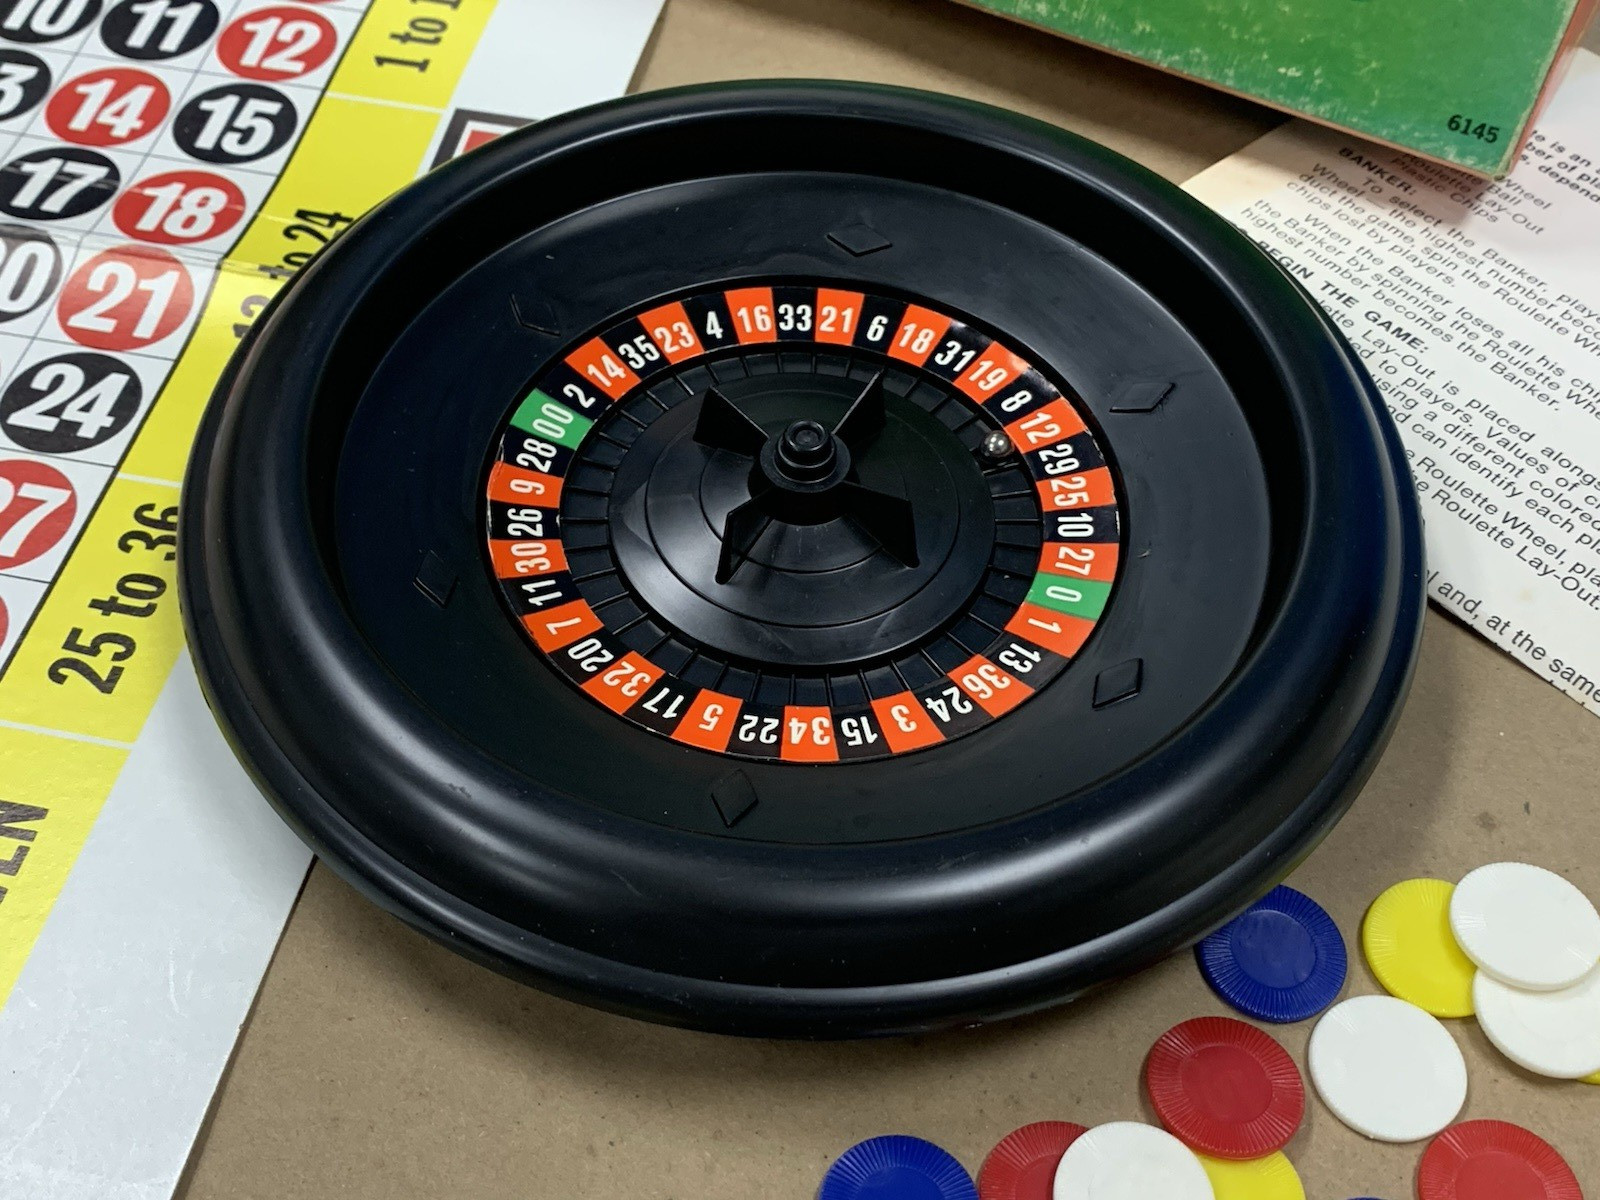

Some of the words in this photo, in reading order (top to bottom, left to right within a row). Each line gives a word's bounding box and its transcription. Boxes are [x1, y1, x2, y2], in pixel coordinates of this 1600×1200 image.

[2, 0, 88, 36] 10
[125, 0, 210, 53] 11
[389, 17, 448, 45] to
[239, 15, 323, 74] 12
[374, 55, 431, 73] 1
[67, 78, 155, 139] 14
[198, 93, 281, 157] 15
[1446, 113, 1499, 145] 6145
[1550, 141, 1566, 153] is
[1569, 153, 1591, 167] an
[1557, 160, 1578, 174] of
[7, 156, 107, 214] 17
[1338, 147, 1417, 196] BANKER:
[135, 181, 229, 239] 18
[1450, 191, 1499, 223] Chips
[1486, 183, 1522, 206] Ball
[1475, 191, 1545, 235] Lay-Out
[1287, 181, 1331, 211] chips
[1332, 208, 1366, 231] lost
[1366, 228, 1390, 244] by
[1388, 244, 1456, 288] players.
[1313, 163, 1366, 198] Wheel
[1389, 208, 1416, 228] the
[1419, 226, 1485, 269] highest
[1487, 268, 1558, 310] number
[1363, 177, 1383, 194] To
[1389, 195, 1443, 227] select
[1447, 228, 1475, 248] the
[1481, 248, 1548, 293] Banker,
[1299, 173, 1338, 197] duct
[1338, 196, 1365, 215] the
[1367, 214, 1416, 248] game,
[1421, 246, 1459, 271] spin
[1461, 269, 1490, 289] the
[1493, 287, 1570, 335] Roulette
[0, 238, 55, 313] 0
[66, 261, 184, 339] 21
[1241, 207, 1304, 249] highest
[1304, 248, 1372, 290] number
[1373, 289, 1454, 343] becomes
[1457, 341, 1487, 363] the
[1490, 361, 1560, 411] Banker.
[1254, 199, 1282, 219] the
[1284, 217, 1346, 257] Banker
[1346, 255, 1370, 273] by
[1371, 272, 1447, 322] spinning
[1450, 319, 1479, 341] the
[1482, 339, 1561, 391] Roulette
[1304, 213, 1352, 246] When
[1355, 246, 1384, 266] the
[1388, 265, 1453, 306] Banker
[1455, 306, 1504, 339] loses
[1508, 339, 1535, 356] all
[1536, 355, 1565, 377] his
[705, 310, 723, 340] 4
[736, 304, 772, 334] 16
[778, 304, 812, 332] 33
[819, 305, 853, 333] 21
[866, 314, 888, 342] 6
[1319, 280, 1360, 309] THE
[1364, 310, 1429, 353] GAME:
[617, 334, 661, 371] 35
[653, 321, 695, 354] 23
[898, 322, 936, 354] 18
[586, 353, 626, 388] 14
[934, 340, 976, 373] 31
[968, 359, 1008, 391] 19
[1361, 329, 1436, 380] Lay-Out
[1442, 380, 1460, 396] is
[1465, 398, 1536, 443] placed
[6, 362, 131, 440] 24
[562, 383, 596, 409] 2
[1000, 389, 1033, 413] 8
[1019, 411, 1061, 444] 12
[1378, 359, 1398, 375] to
[1401, 377, 1473, 427] players.
[1486, 426, 1550, 475] Values
[1555, 477, 1581, 492] of
[515, 437, 558, 474] 28
[1038, 443, 1079, 475] 29
[1423, 410, 1438, 422] a
[1443, 422, 1525, 478] different
[509, 478, 546, 496] 9
[1050, 475, 1090, 507] 25
[1412, 423, 1447, 449] can
[1449, 446, 1524, 498] identify
[1525, 498, 1575, 533] each
[0, 476, 72, 558] 7
[507, 507, 543, 538] 26
[1057, 512, 1094, 538] 10
[1416, 456, 1499, 515] Roulette
[1501, 511, 1567, 565] Wheel,
[510, 541, 551, 574] 30
[1054, 545, 1095, 576] 27
[1431, 488, 1514, 548] Roulette
[1516, 545, 1600, 611] Lay-Out.
[88, 572, 167, 618] to
[521, 579, 563, 607] 11
[1045, 585, 1083, 603] 0
[545, 616, 582, 636] 7
[1027, 616, 1063, 635] 1
[1438, 582, 1482, 620] and,
[1486, 615, 1512, 635] at
[1511, 629, 1547, 661] the
[47, 627, 137, 694] 25
[567, 637, 615, 673] 20
[998, 642, 1042, 674] 13
[602, 660, 652, 697] 32
[961, 663, 1012, 700] 36
[642, 687, 685, 719] 17
[698, 703, 724, 732] 5
[890, 704, 917, 733] 3
[924, 686, 974, 723] 24
[738, 714, 780, 745] 22
[788, 716, 831, 746] 34
[840, 715, 878, 747] 15
